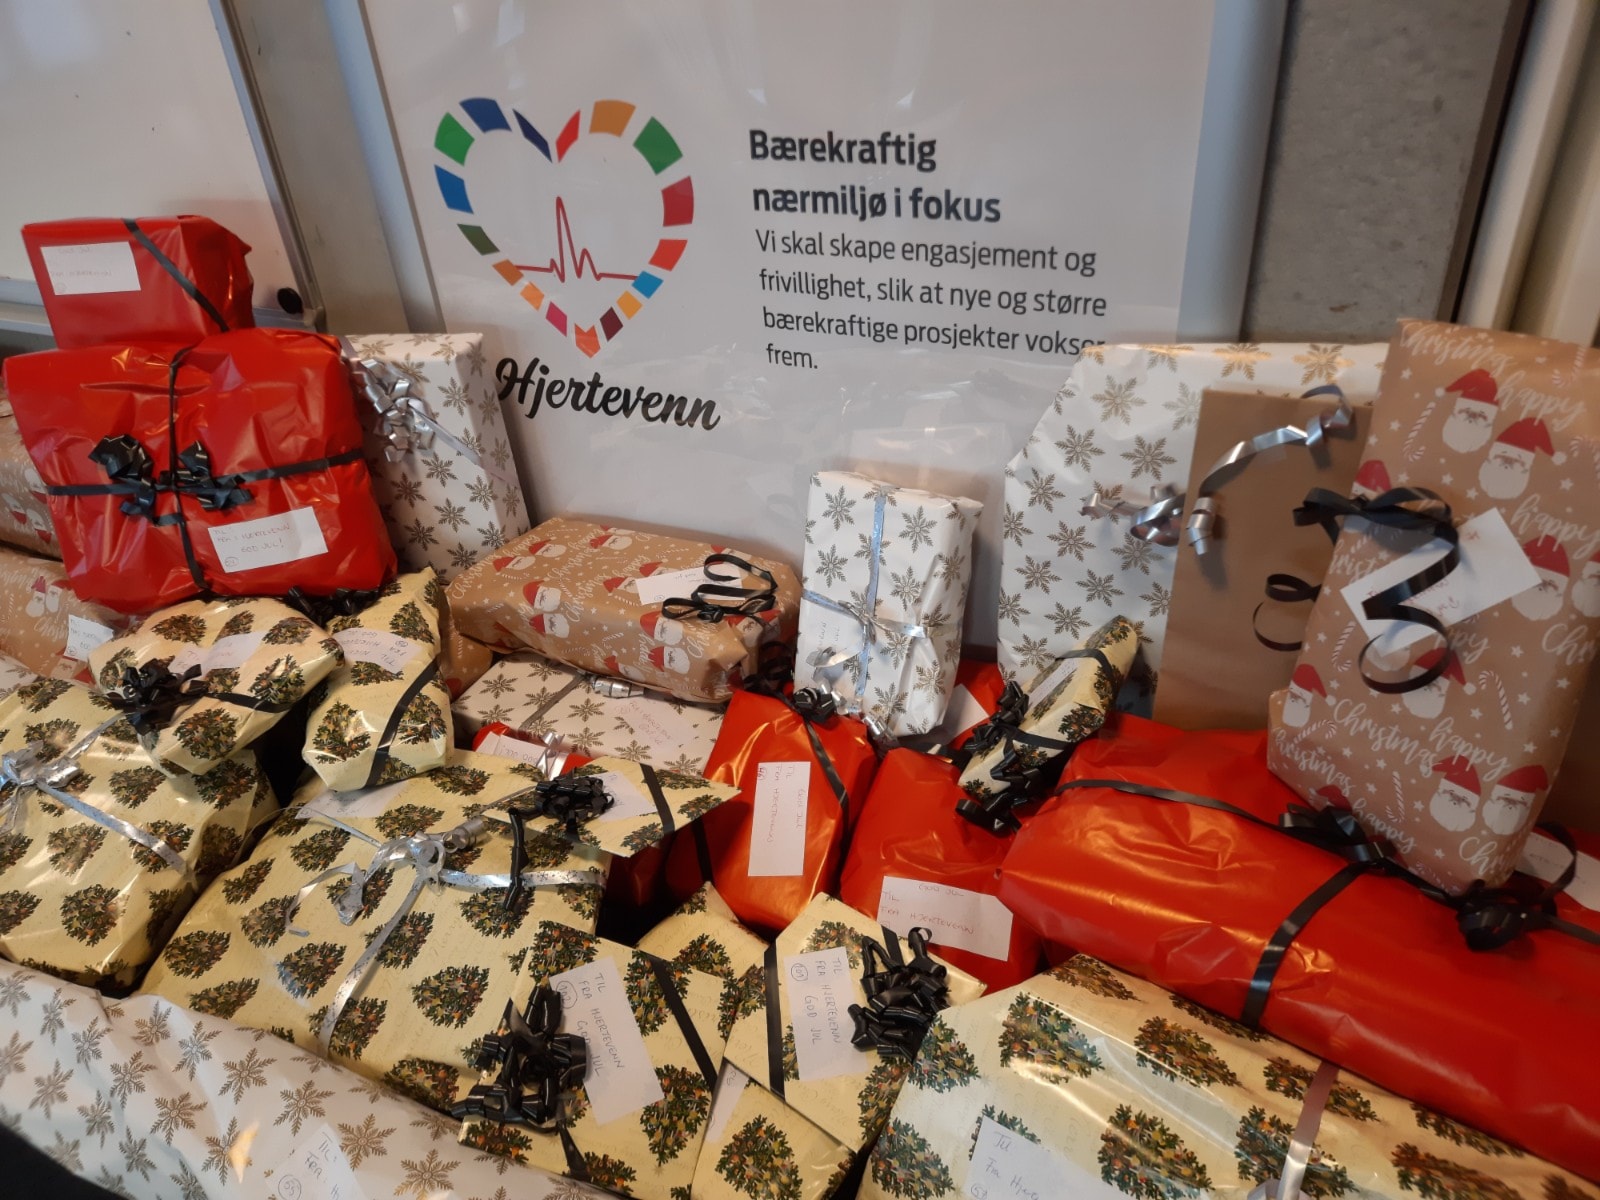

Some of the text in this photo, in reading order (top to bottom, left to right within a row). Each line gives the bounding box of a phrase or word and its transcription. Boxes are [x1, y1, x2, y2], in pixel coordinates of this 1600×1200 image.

[749, 129, 937, 173] Bærekraftig
[753, 185, 1001, 223] nærmiljø i fokus
[756, 229, 1096, 278] Vi skal skape engasjement og
[759, 268, 1107, 317] frivillighet, slik at nye og større
[763, 306, 898, 343] bærekraftige
[904, 323, 1019, 349] prosjekter
[766, 343, 818, 369] frem.
[495, 356, 721, 431] Hjertevenn
[1333, 698, 1438, 778] Christmas
